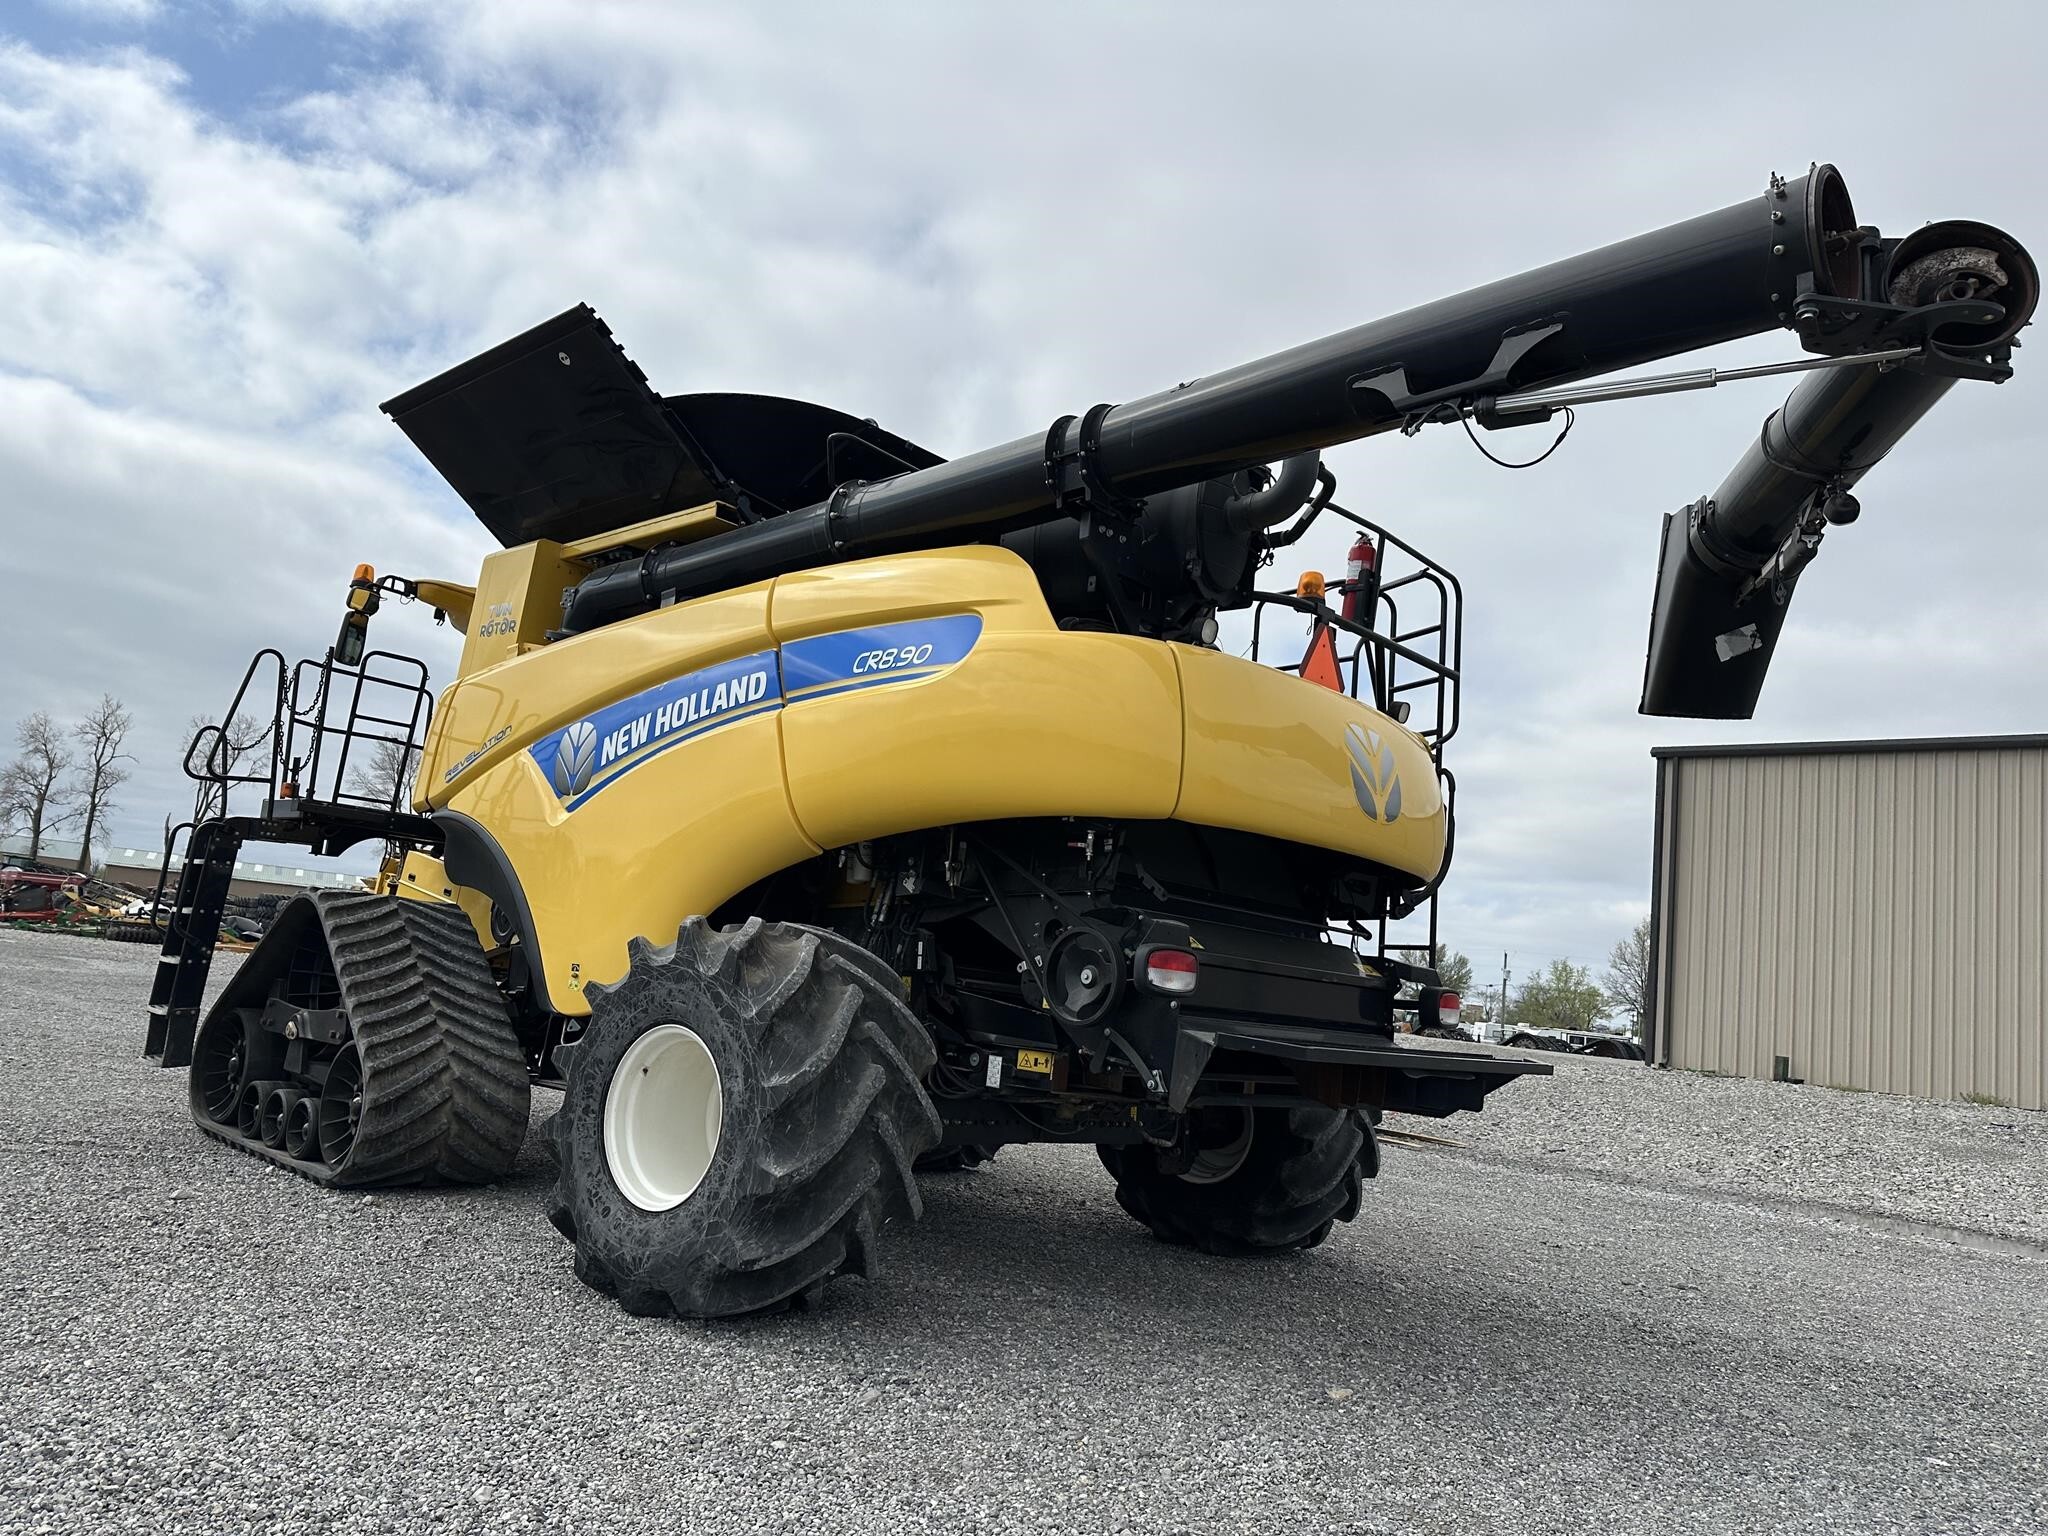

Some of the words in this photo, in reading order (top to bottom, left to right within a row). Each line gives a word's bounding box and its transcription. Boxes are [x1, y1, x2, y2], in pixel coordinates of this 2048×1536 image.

[488, 603, 512, 618] TWIN
[480, 619, 516, 637] ROTOR
[852, 643, 933, 674] CR8.90
[600, 712, 652, 767] NEW
[654, 671, 767, 737] HOLLAND
[444, 724, 512, 780] REVELATION
